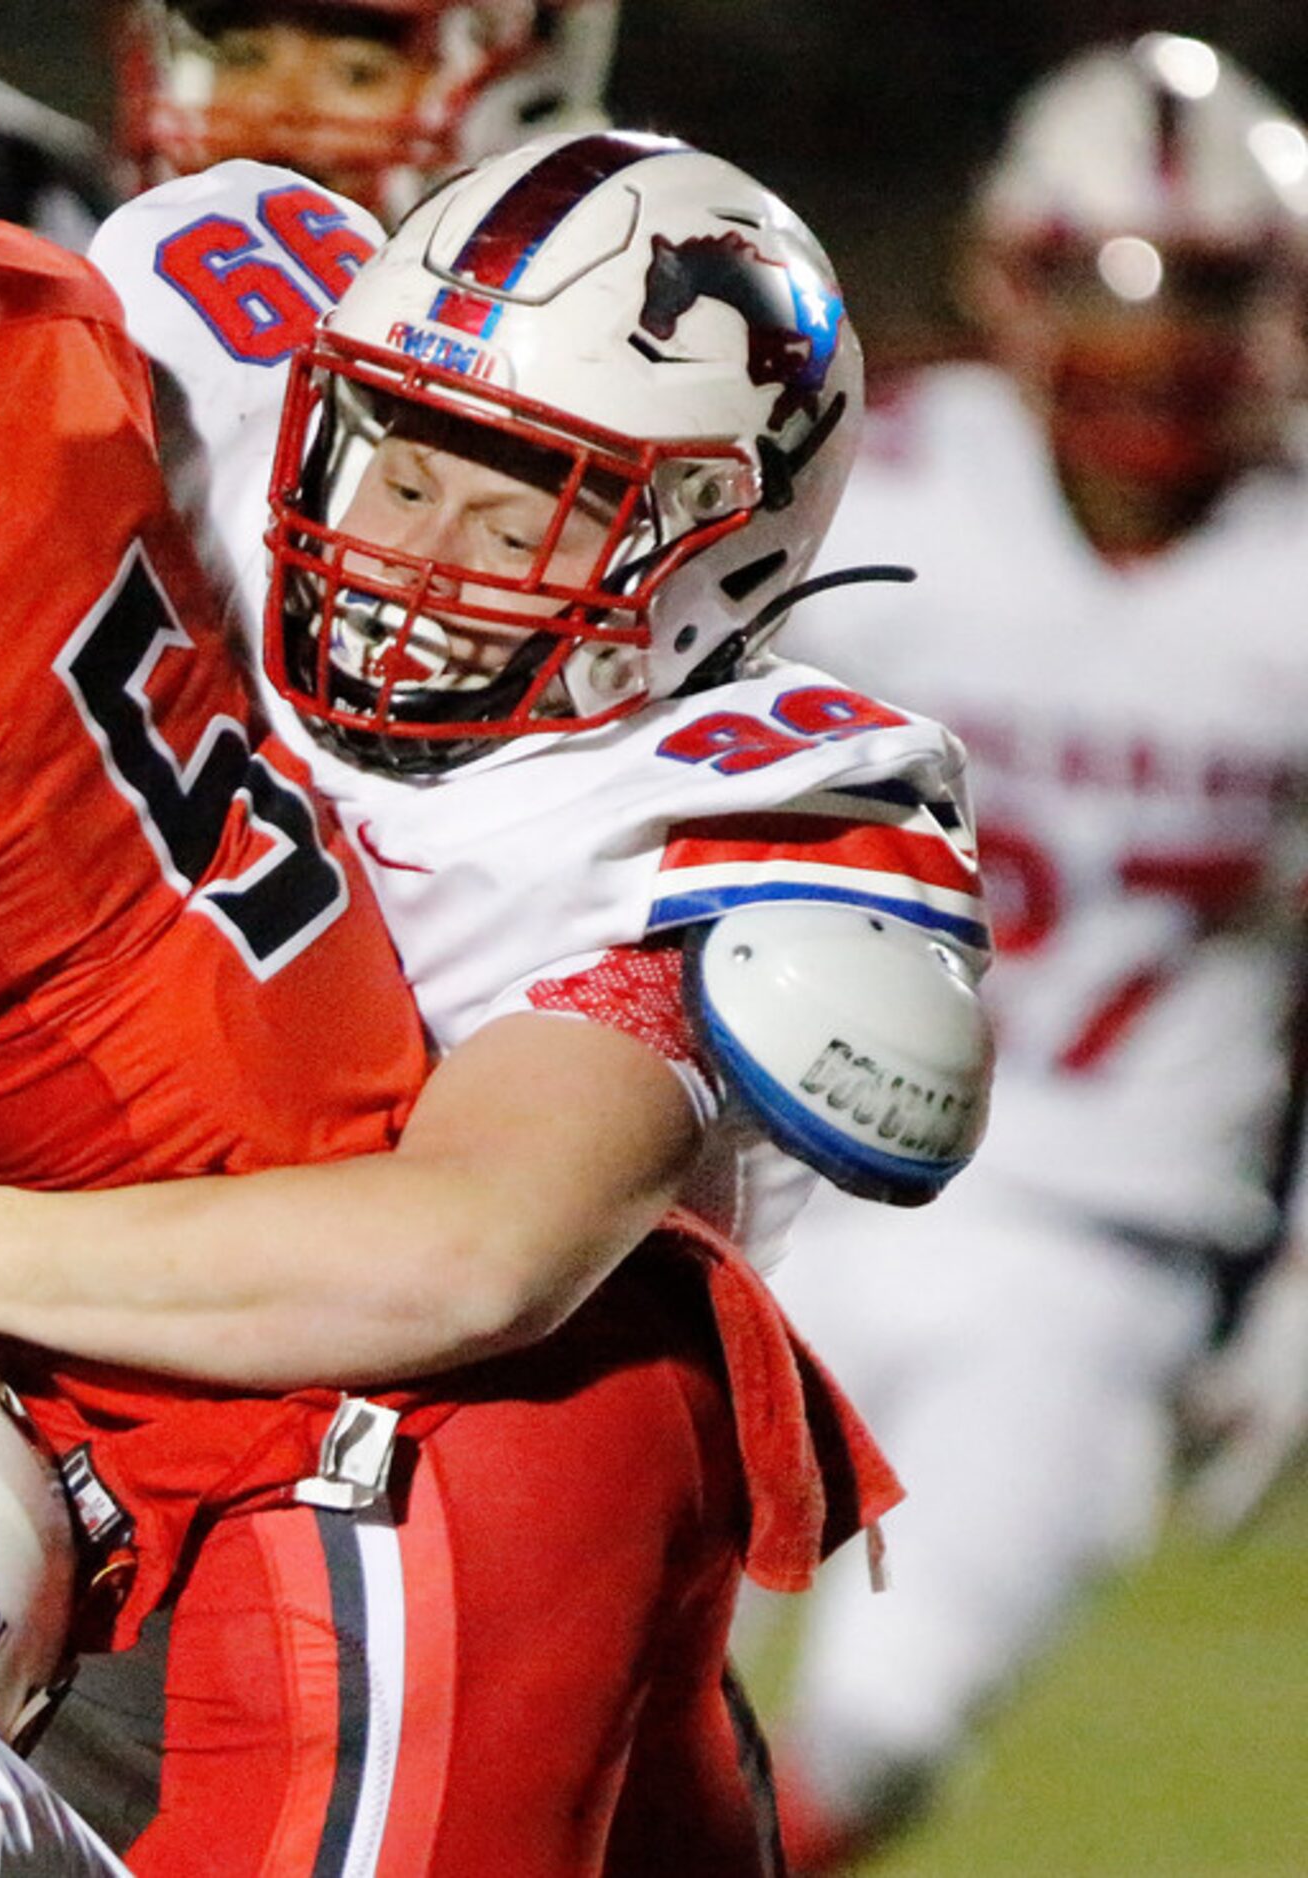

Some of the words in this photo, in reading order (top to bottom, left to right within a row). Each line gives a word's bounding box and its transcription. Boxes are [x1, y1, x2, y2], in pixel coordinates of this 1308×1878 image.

[153, 183, 380, 368] 66
[51, 537, 350, 984] 5
[655, 685, 913, 776] 99
